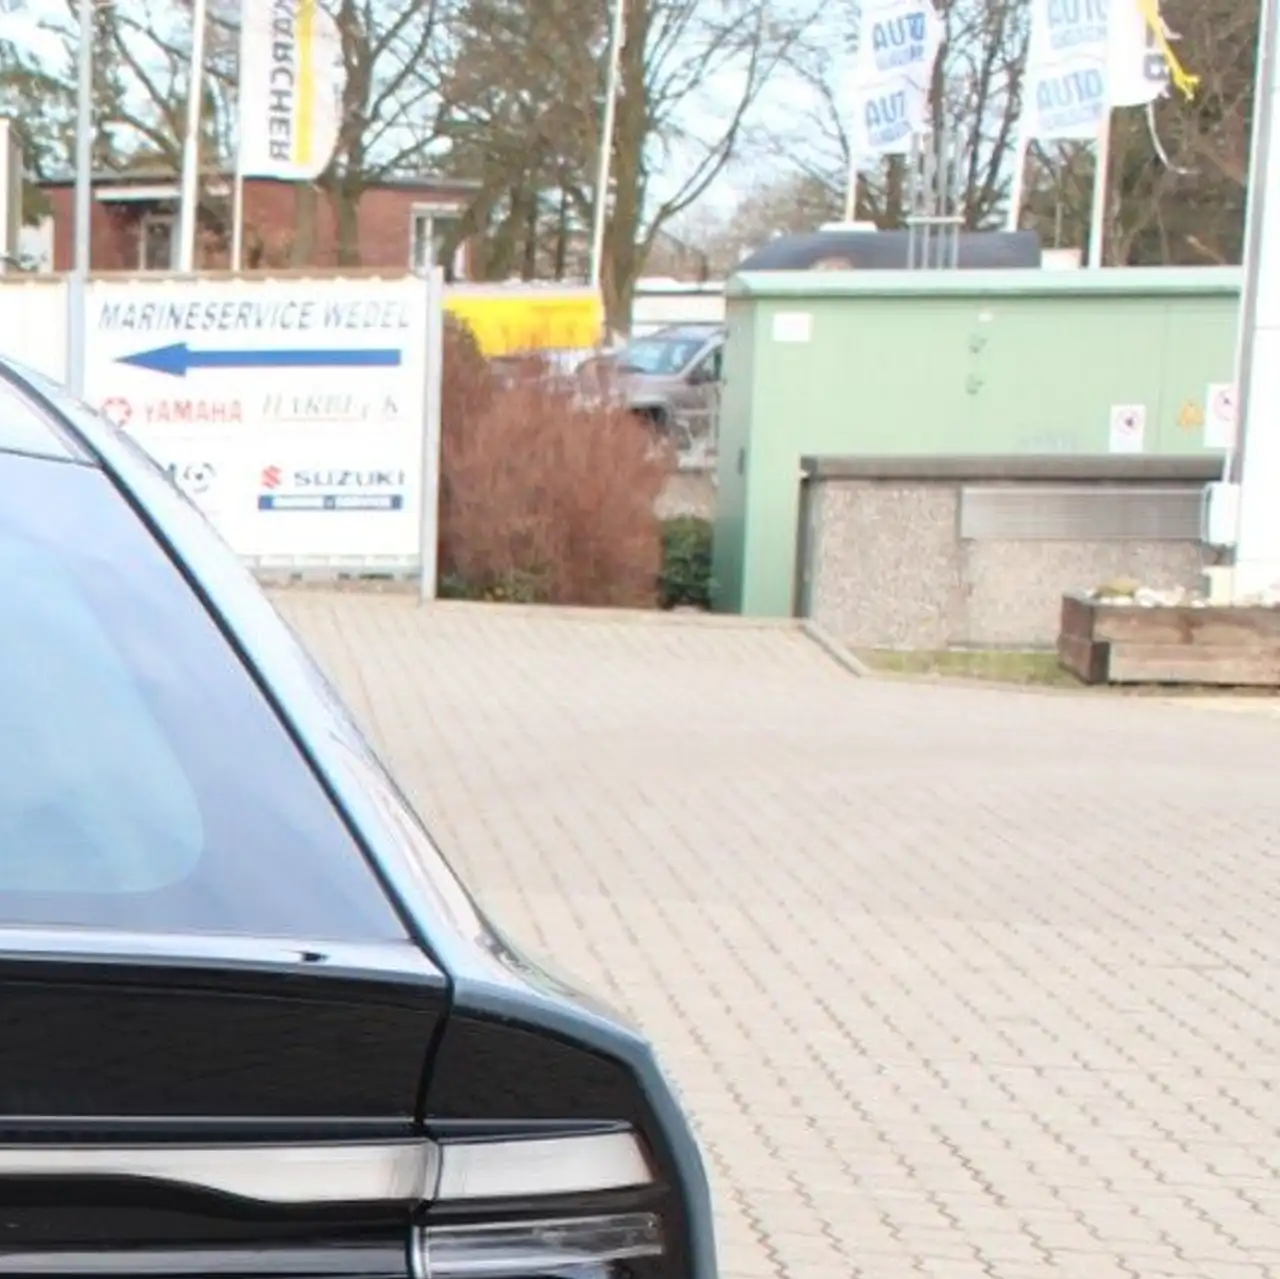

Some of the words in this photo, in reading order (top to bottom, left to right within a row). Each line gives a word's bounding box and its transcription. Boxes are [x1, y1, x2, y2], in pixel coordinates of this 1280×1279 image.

[98, 300, 315, 331] MARINESERVICE
[323, 300, 410, 329] WEDEL
[145, 399, 243, 424] YAMAHA
[294, 469, 405, 487] SUZUKI
